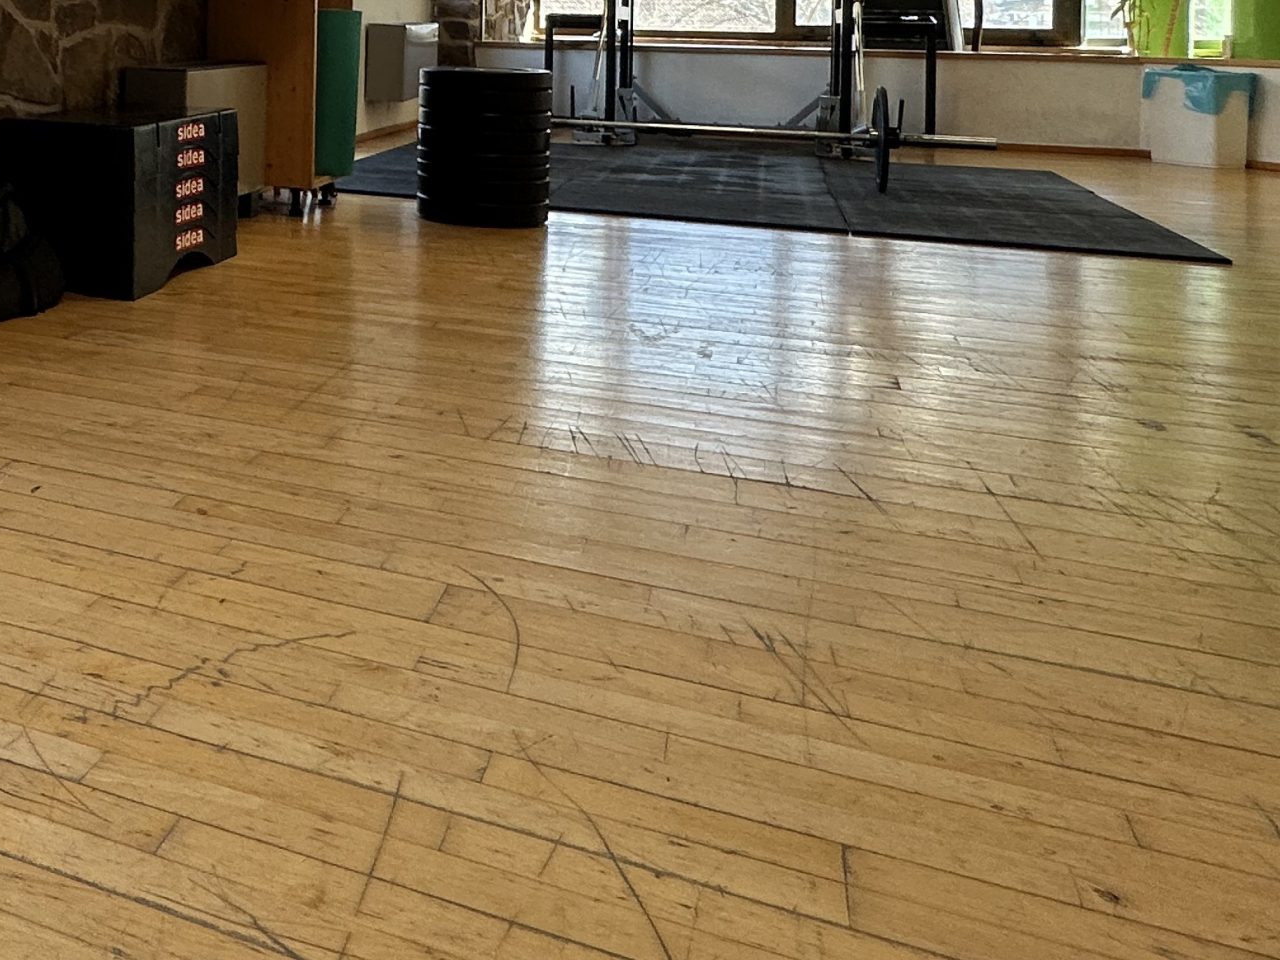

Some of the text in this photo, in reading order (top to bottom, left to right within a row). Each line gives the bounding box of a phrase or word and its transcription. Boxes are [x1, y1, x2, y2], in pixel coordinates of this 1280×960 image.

[177, 123, 205, 140] sidea
[177, 150, 205, 167] sidea
[176, 179, 203, 198] sidea
[176, 204, 203, 223] sidea
[176, 230, 203, 250] sidea
